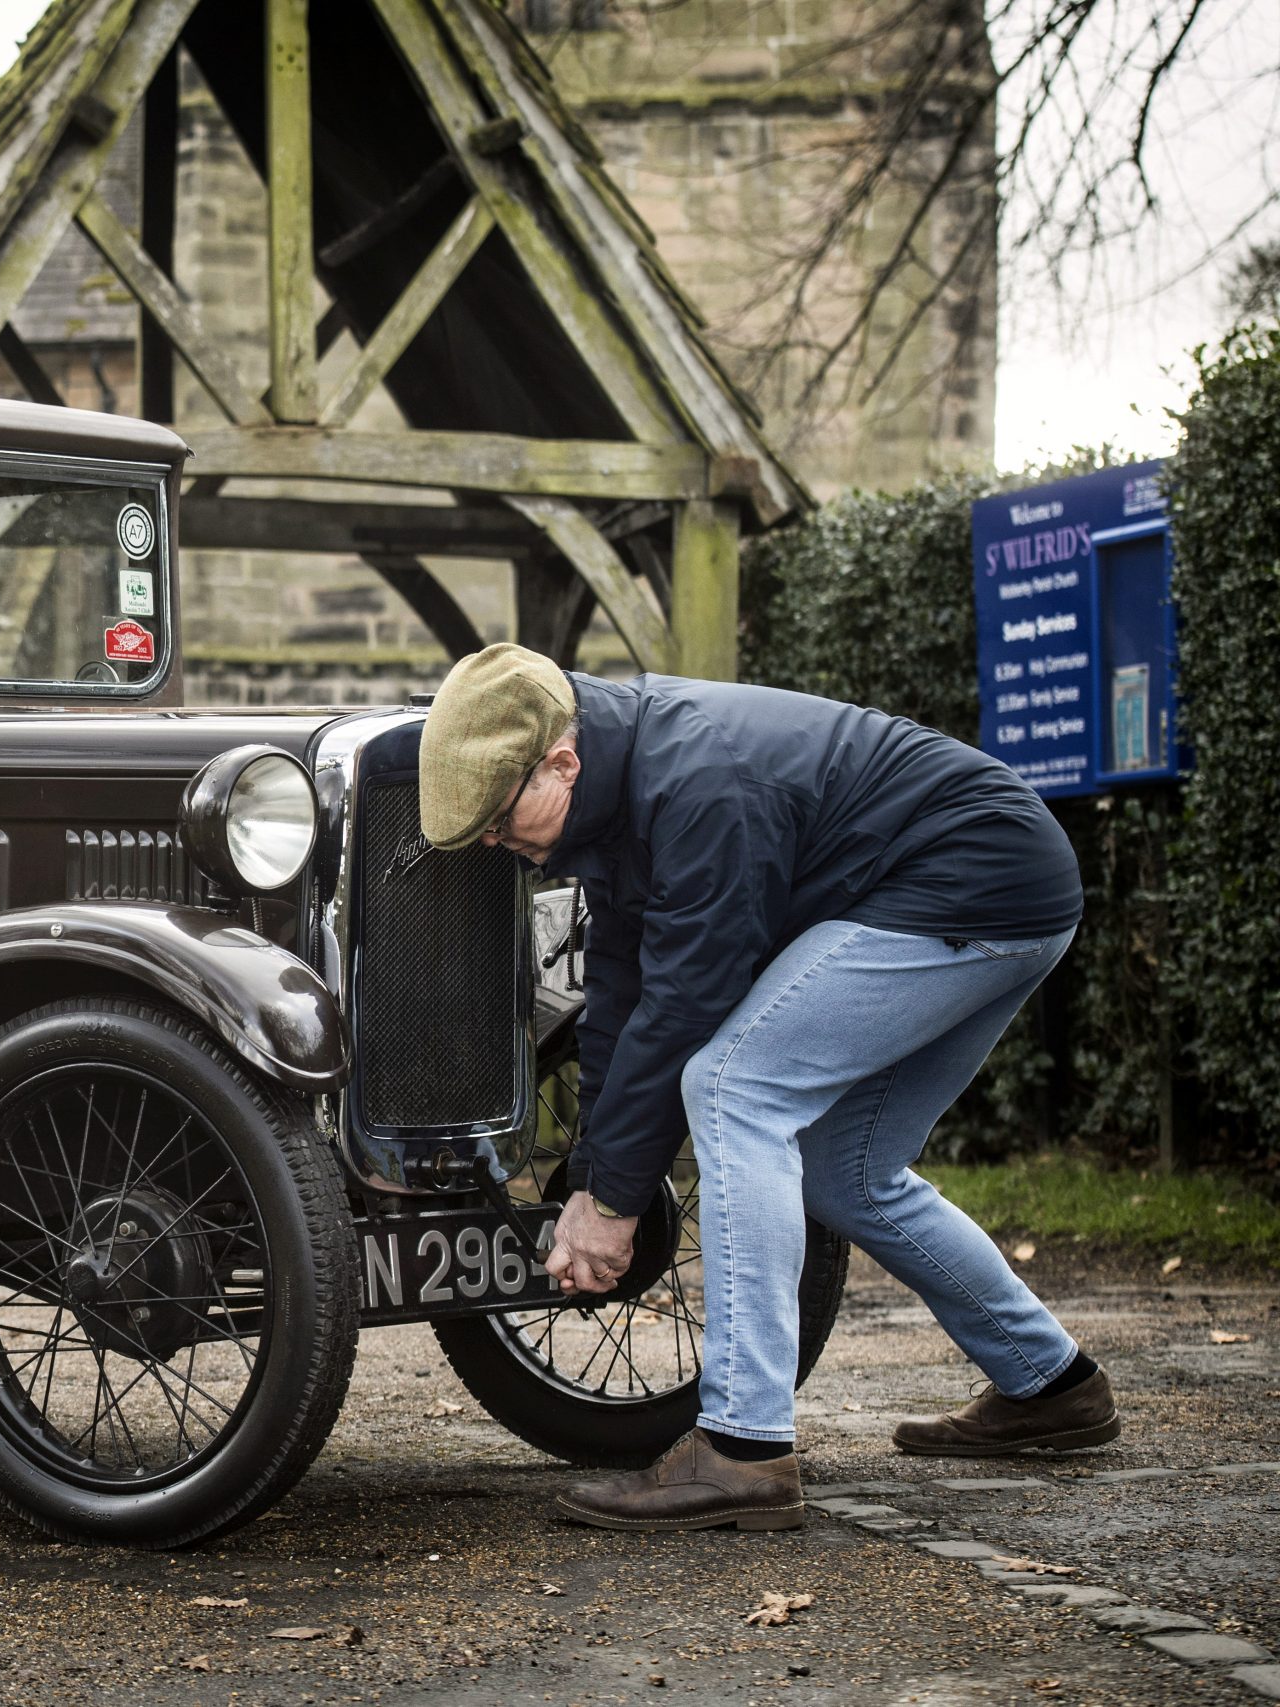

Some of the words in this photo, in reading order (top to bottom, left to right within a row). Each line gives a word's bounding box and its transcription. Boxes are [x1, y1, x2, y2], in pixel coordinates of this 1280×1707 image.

[1010, 502, 1051, 526] Welcome
[1051, 501, 1064, 518] to
[129, 524, 143, 539] A7
[1002, 521, 1091, 570] WILFRID'S
[1032, 576, 1053, 594] Parish
[1053, 570, 1079, 590] Church
[1002, 621, 1036, 642] Sunday
[1036, 612, 1077, 636] Services
[1028, 658, 1045, 678] Holy
[1045, 652, 1089, 674] Communion
[1052, 685, 1080, 704] Service
[1031, 720, 1059, 740] Evening
[1059, 716, 1085, 736] Service
[26, 1037, 80, 1058] SIDECAR
[86, 1037, 134, 1053] TRIPLE
[141, 1048, 176, 1069] DUTY
